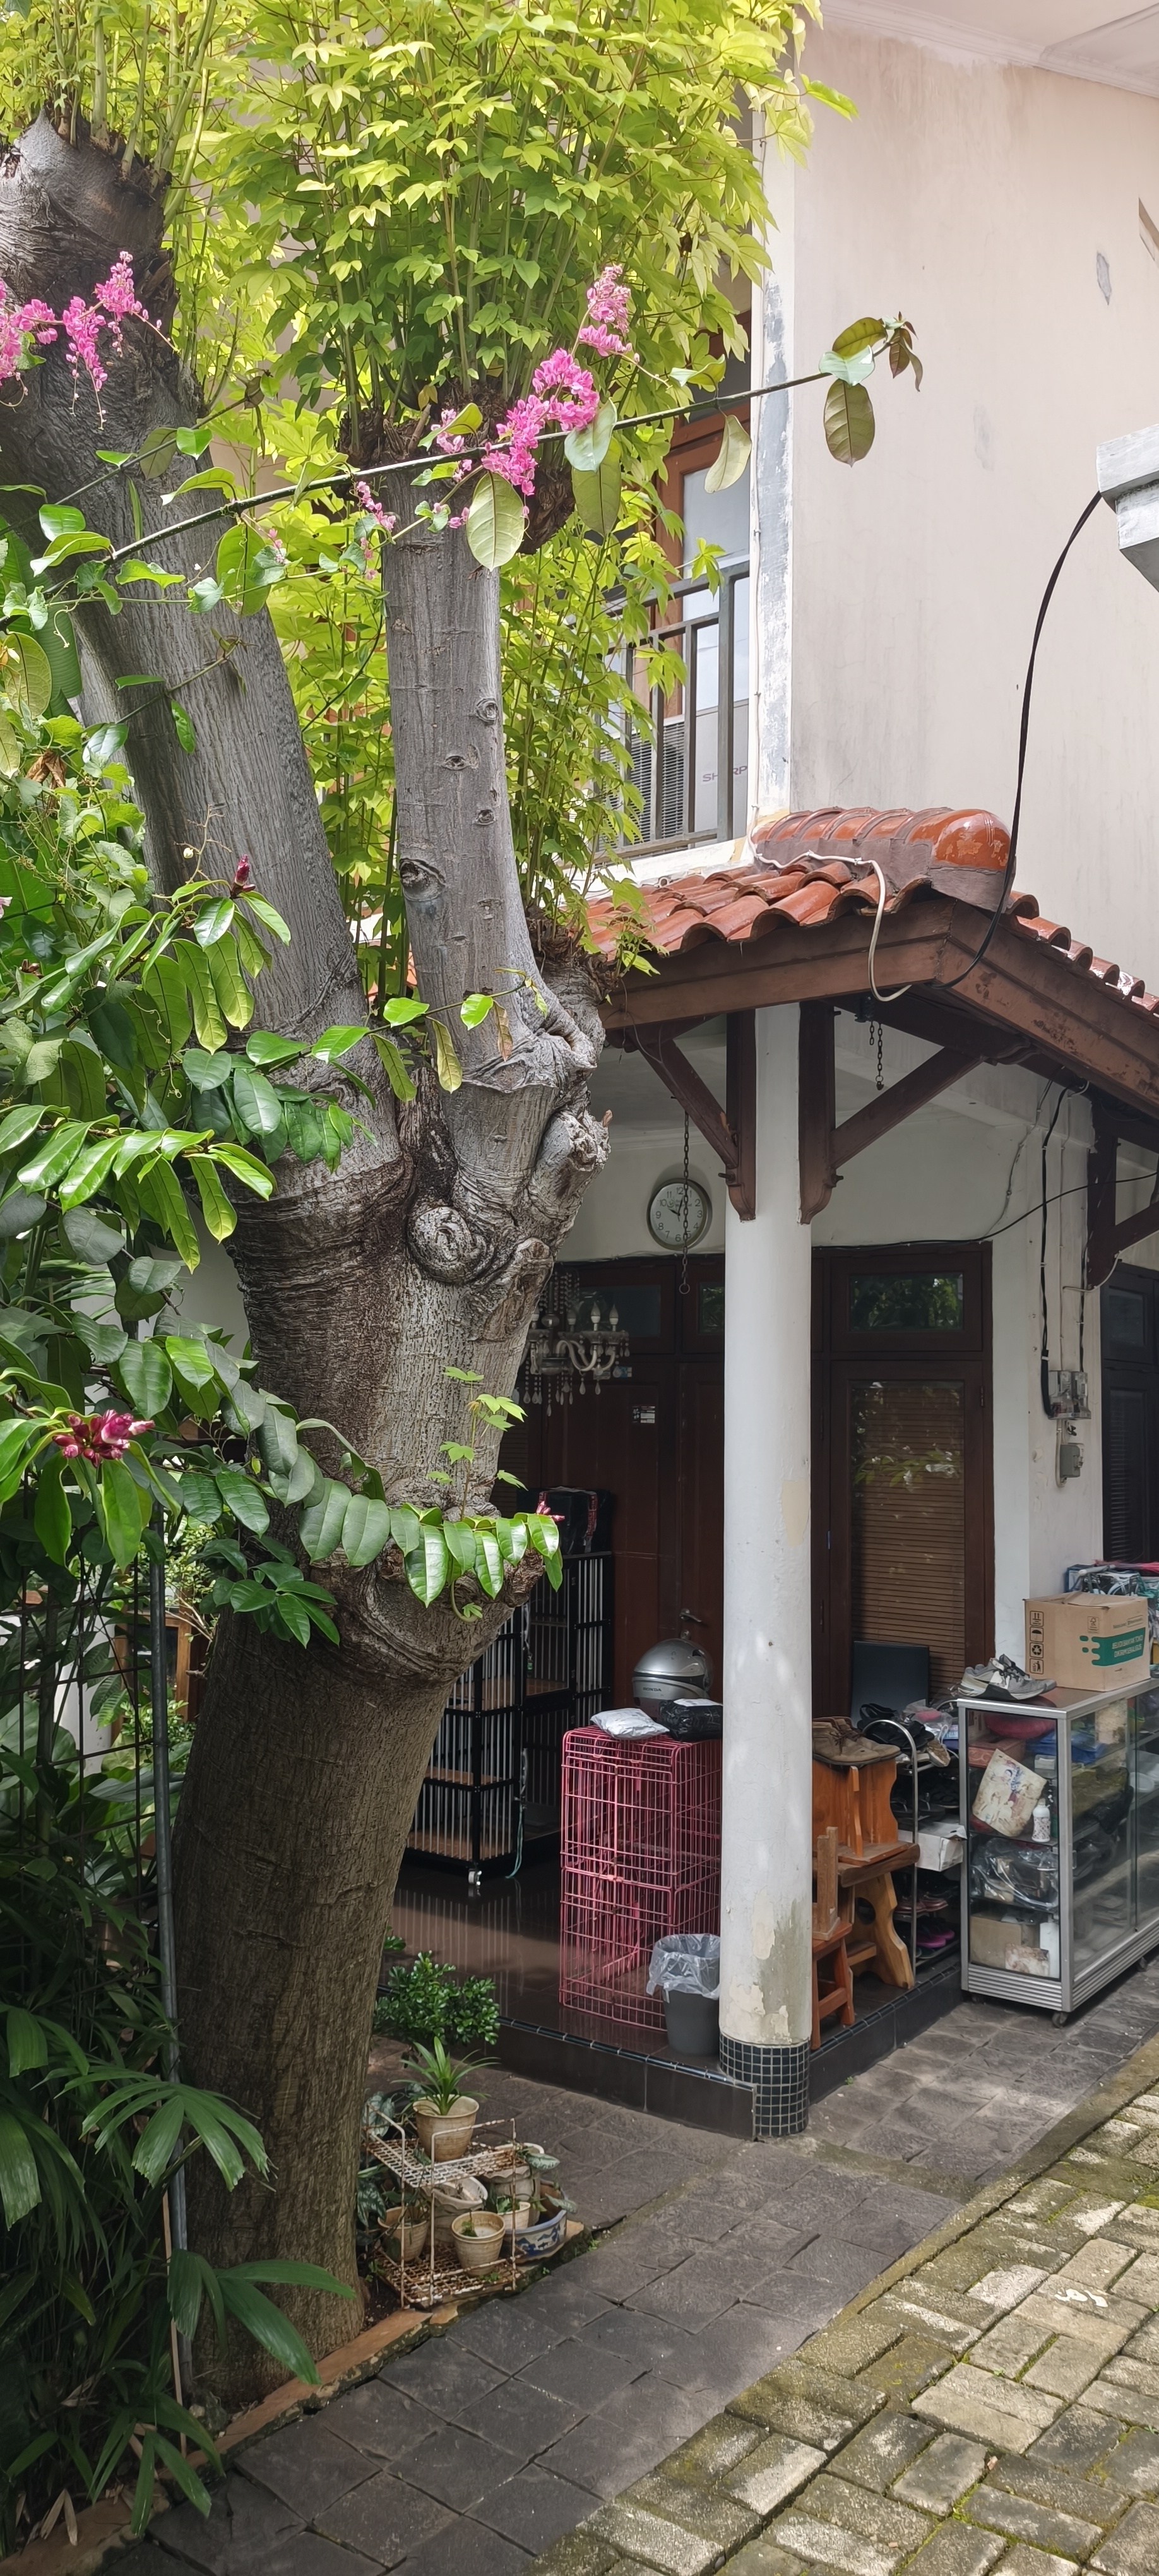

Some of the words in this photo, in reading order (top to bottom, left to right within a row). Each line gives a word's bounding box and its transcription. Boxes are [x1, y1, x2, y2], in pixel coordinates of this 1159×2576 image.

[703, 765, 747, 782] SHRP
[697, 1210, 703, 1218] 3
[658, 1222, 663, 1231] 8
